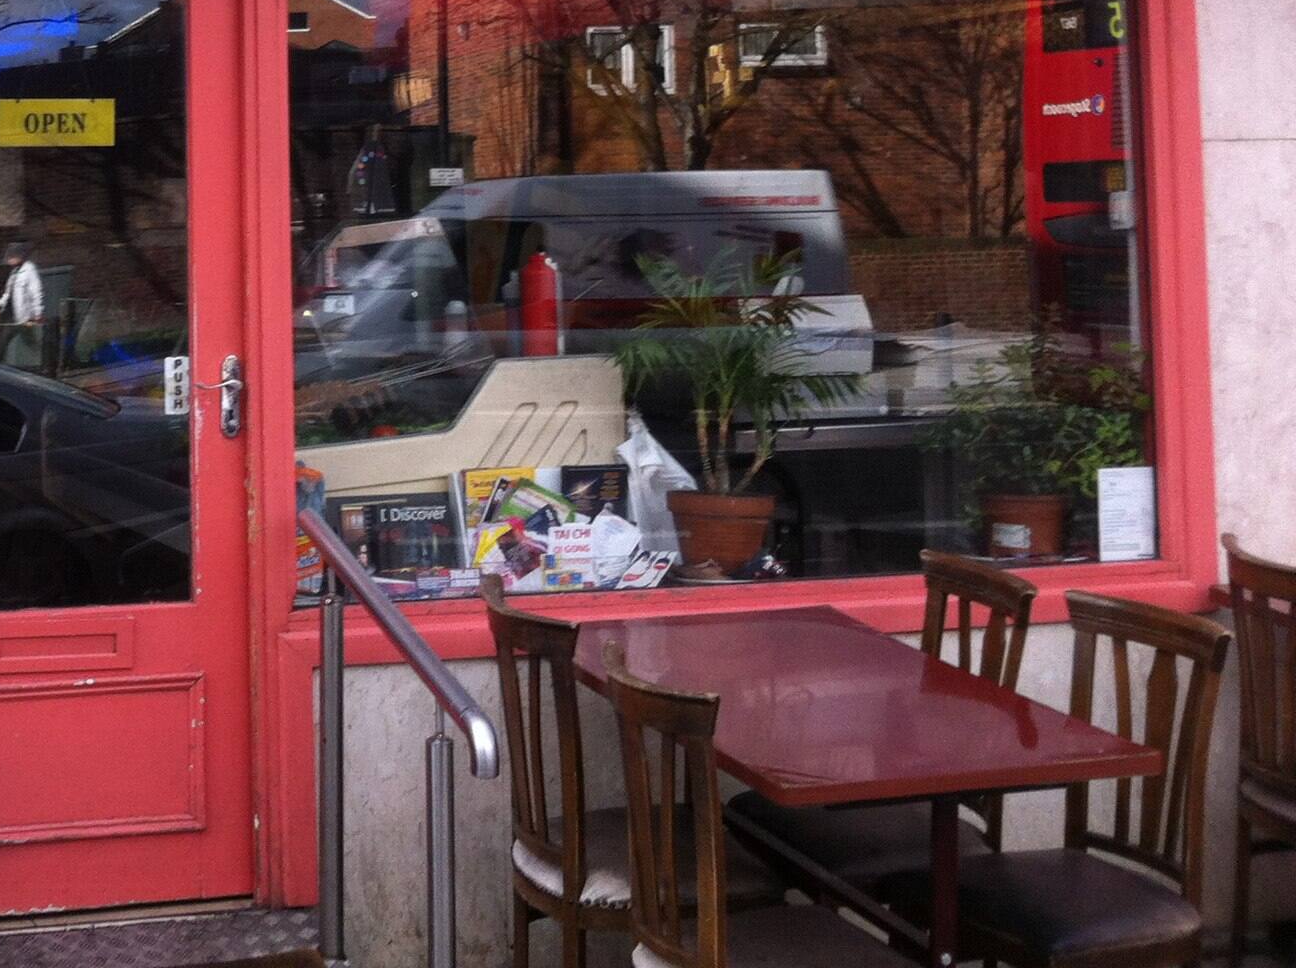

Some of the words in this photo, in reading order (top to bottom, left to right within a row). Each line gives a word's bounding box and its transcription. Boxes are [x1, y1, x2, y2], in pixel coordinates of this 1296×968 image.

[24, 113, 87, 134] OPEN
[173, 359, 183, 409] PUSH
[389, 507, 446, 522] Discover
[572, 529, 591, 539] CHI
